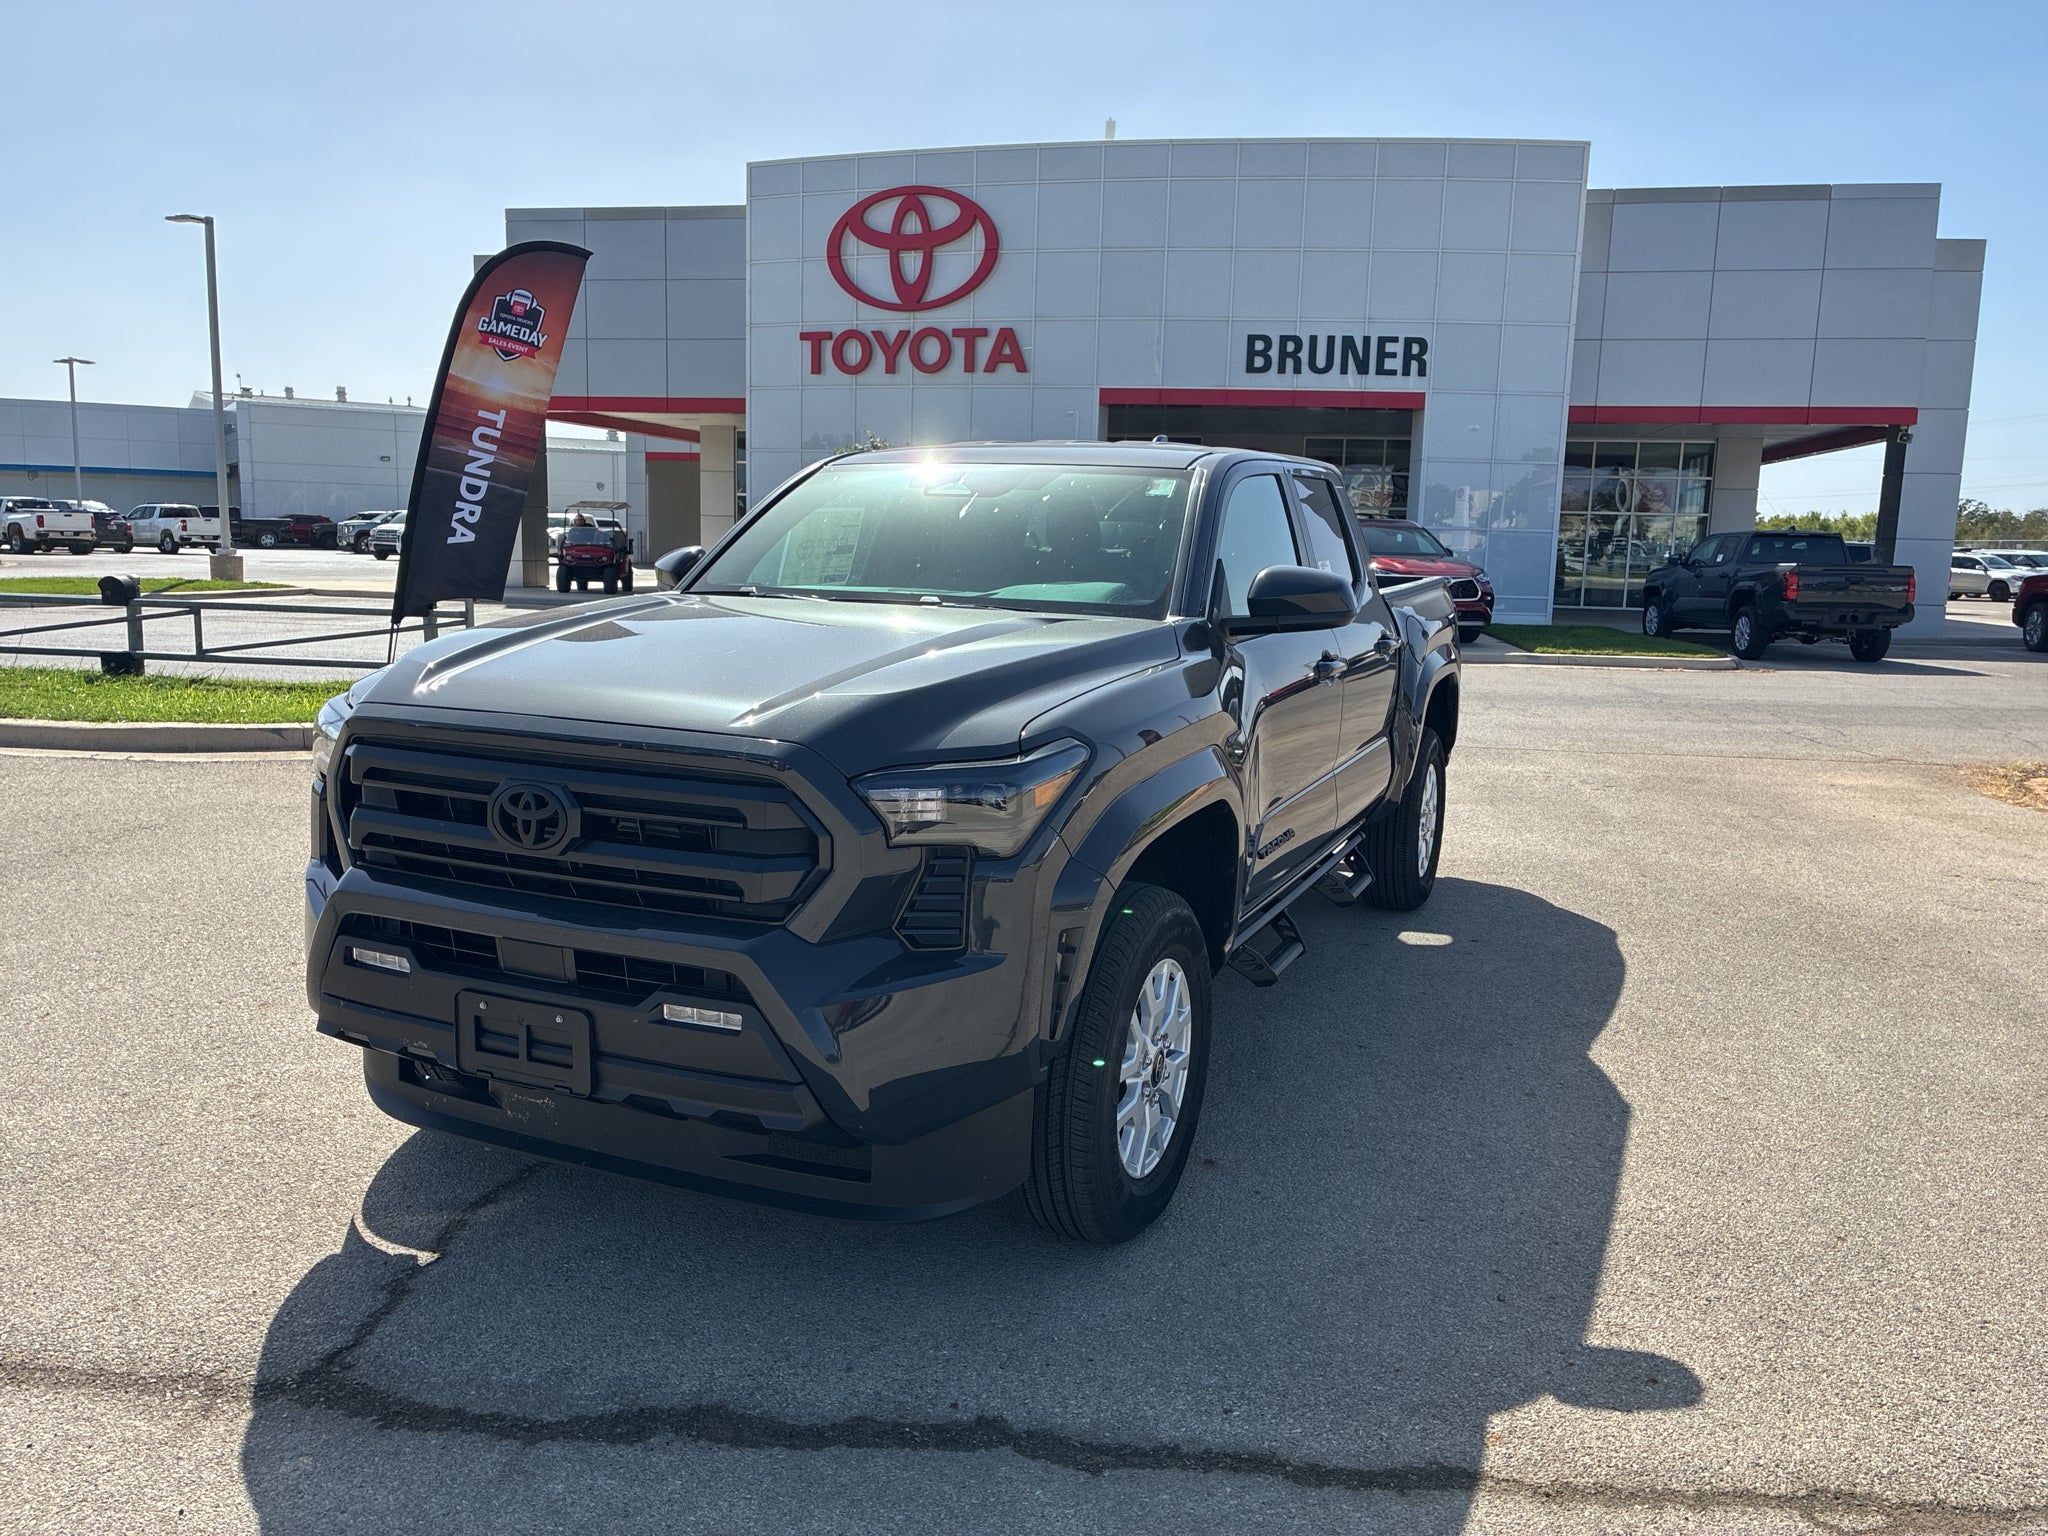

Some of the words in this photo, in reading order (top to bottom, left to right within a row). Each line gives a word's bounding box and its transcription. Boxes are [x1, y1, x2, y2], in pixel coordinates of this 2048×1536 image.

[478, 316, 548, 348] GAMEDAY
[488, 337, 507, 348] SALES
[507, 342, 529, 353] EVENT
[800, 327, 1029, 376] TOYOTA
[1245, 333, 1429, 378] BRUNER
[447, 409, 507, 545] TUNDRA
[1259, 829, 1295, 858] TACOMA
